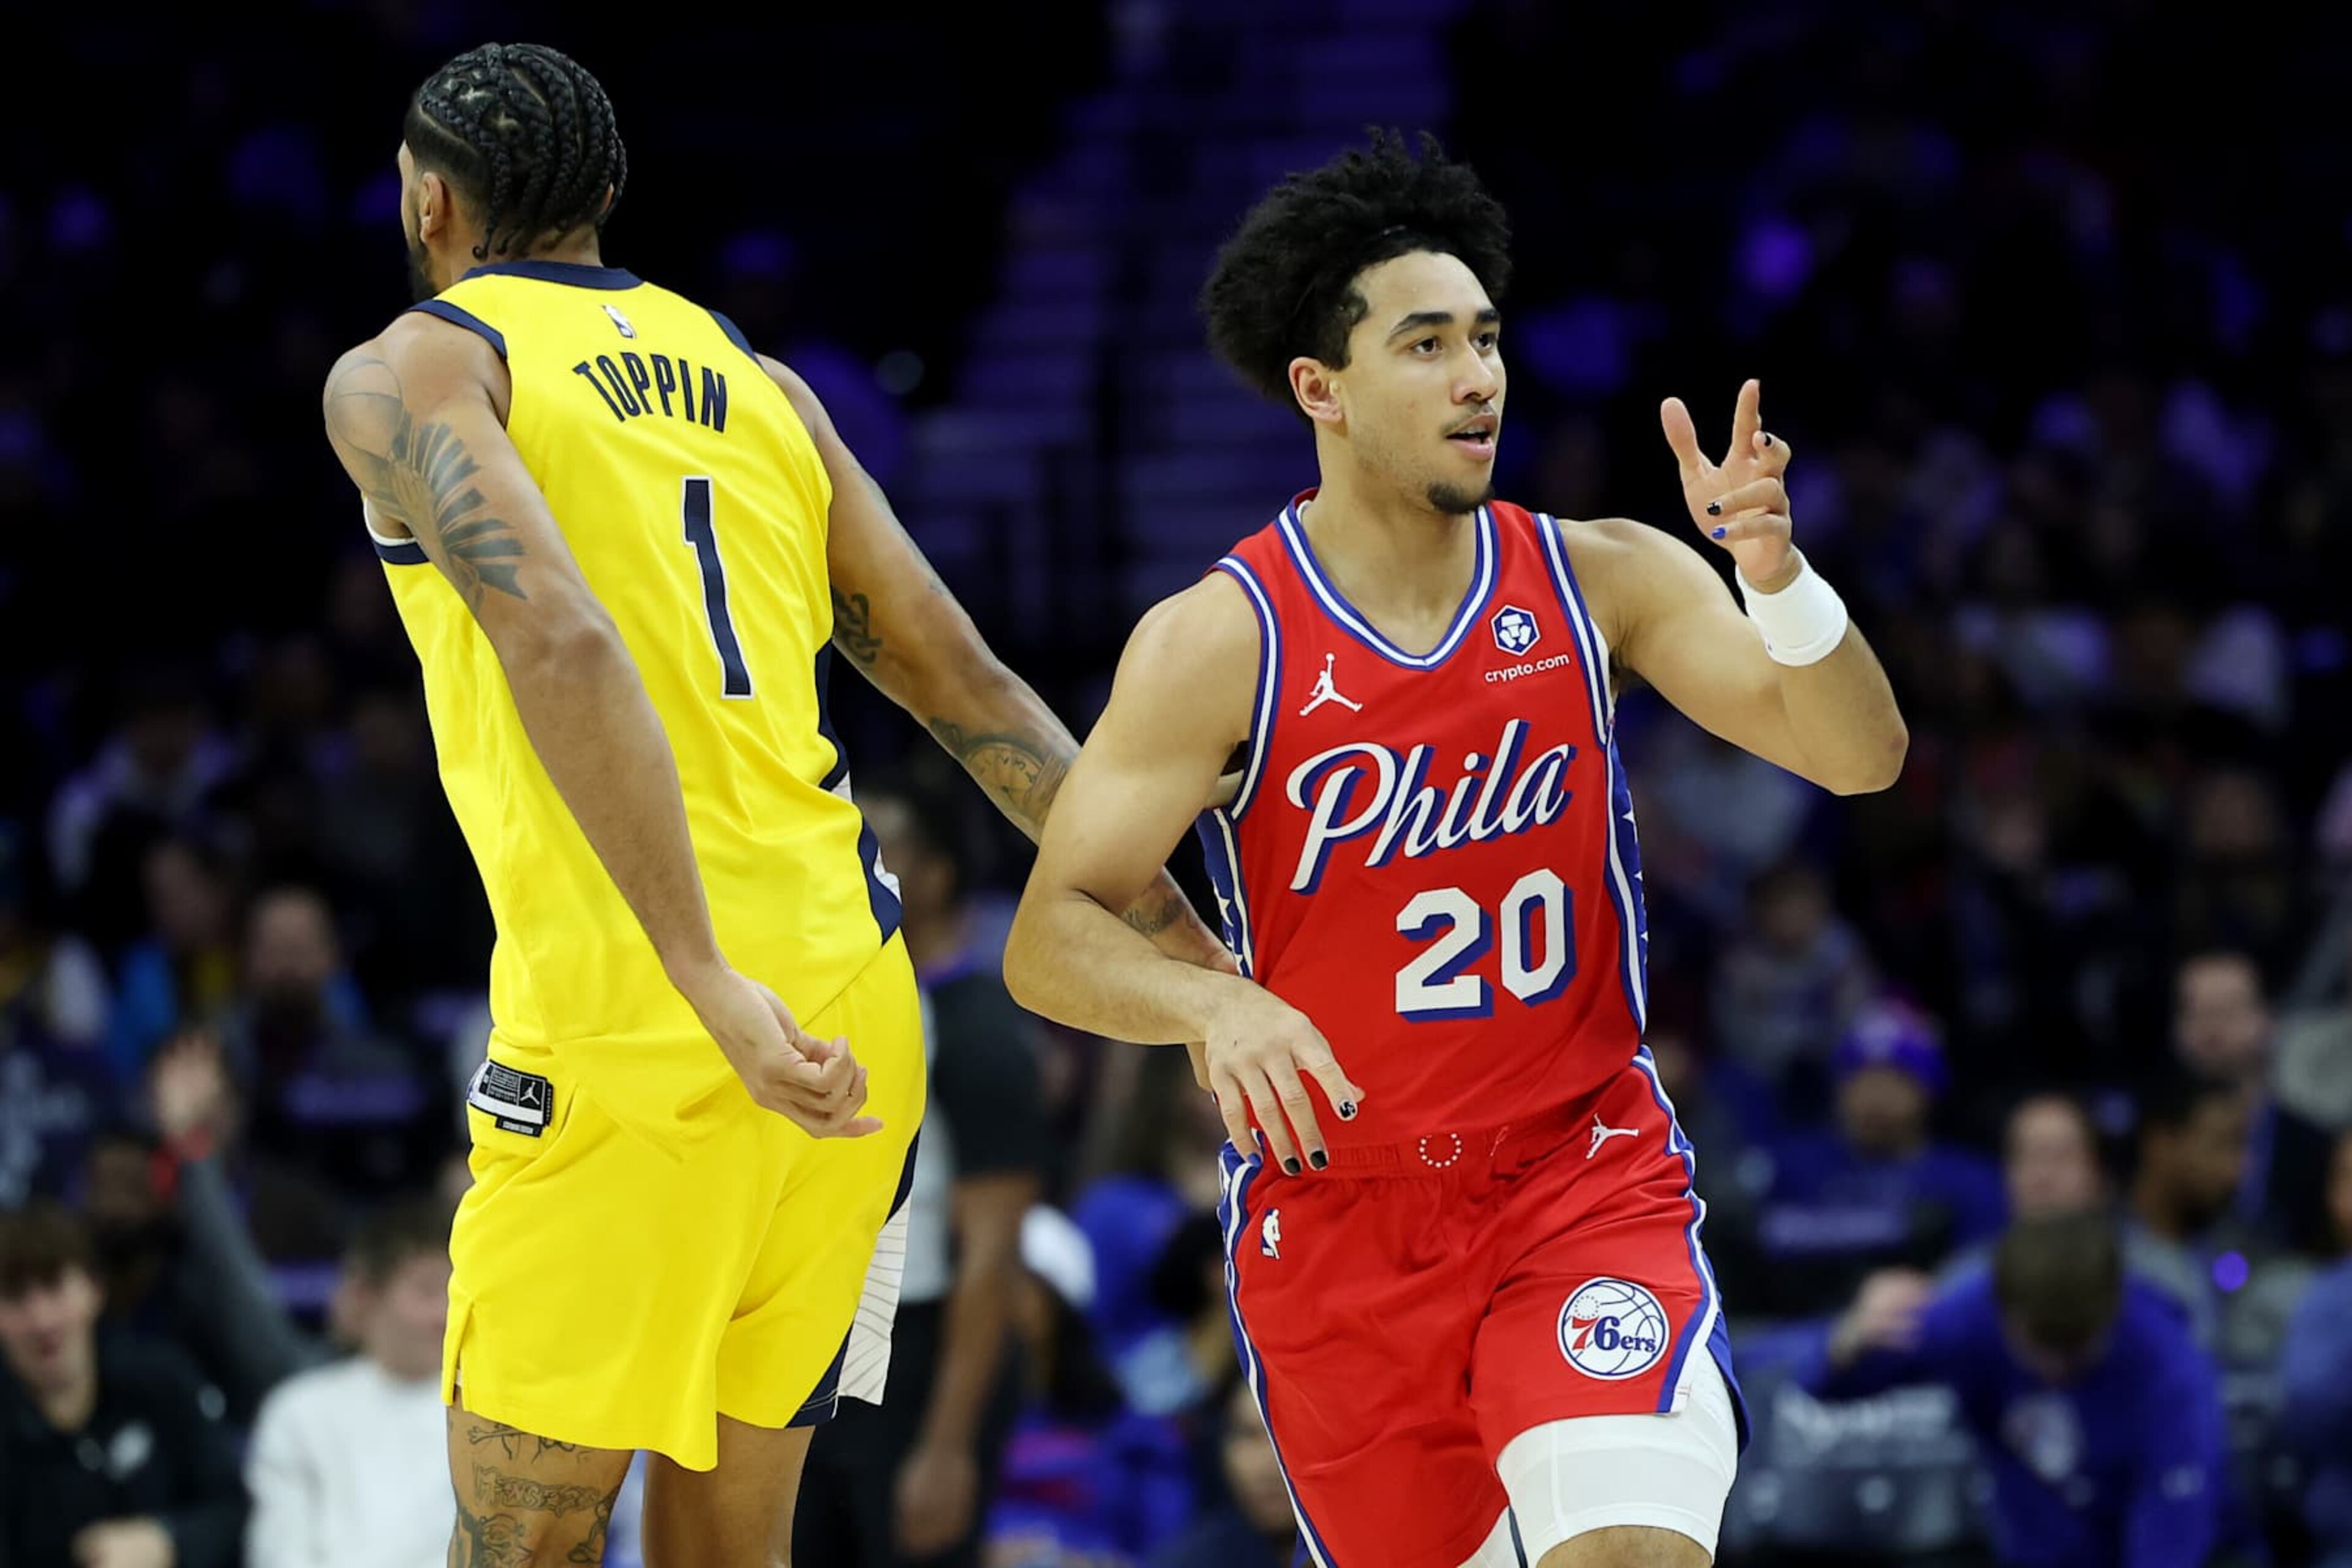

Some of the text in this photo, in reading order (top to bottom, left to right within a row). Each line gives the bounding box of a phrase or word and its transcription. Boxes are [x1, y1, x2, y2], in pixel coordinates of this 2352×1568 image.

[573, 352, 727, 433] TOPPIN
[680, 477, 753, 699] 1
[1485, 654, 1569, 682] crypto.com
[1287, 718, 1576, 894] Phila
[1396, 869, 1576, 1021] 20
[1571, 1316, 1656, 1352] 76ers
